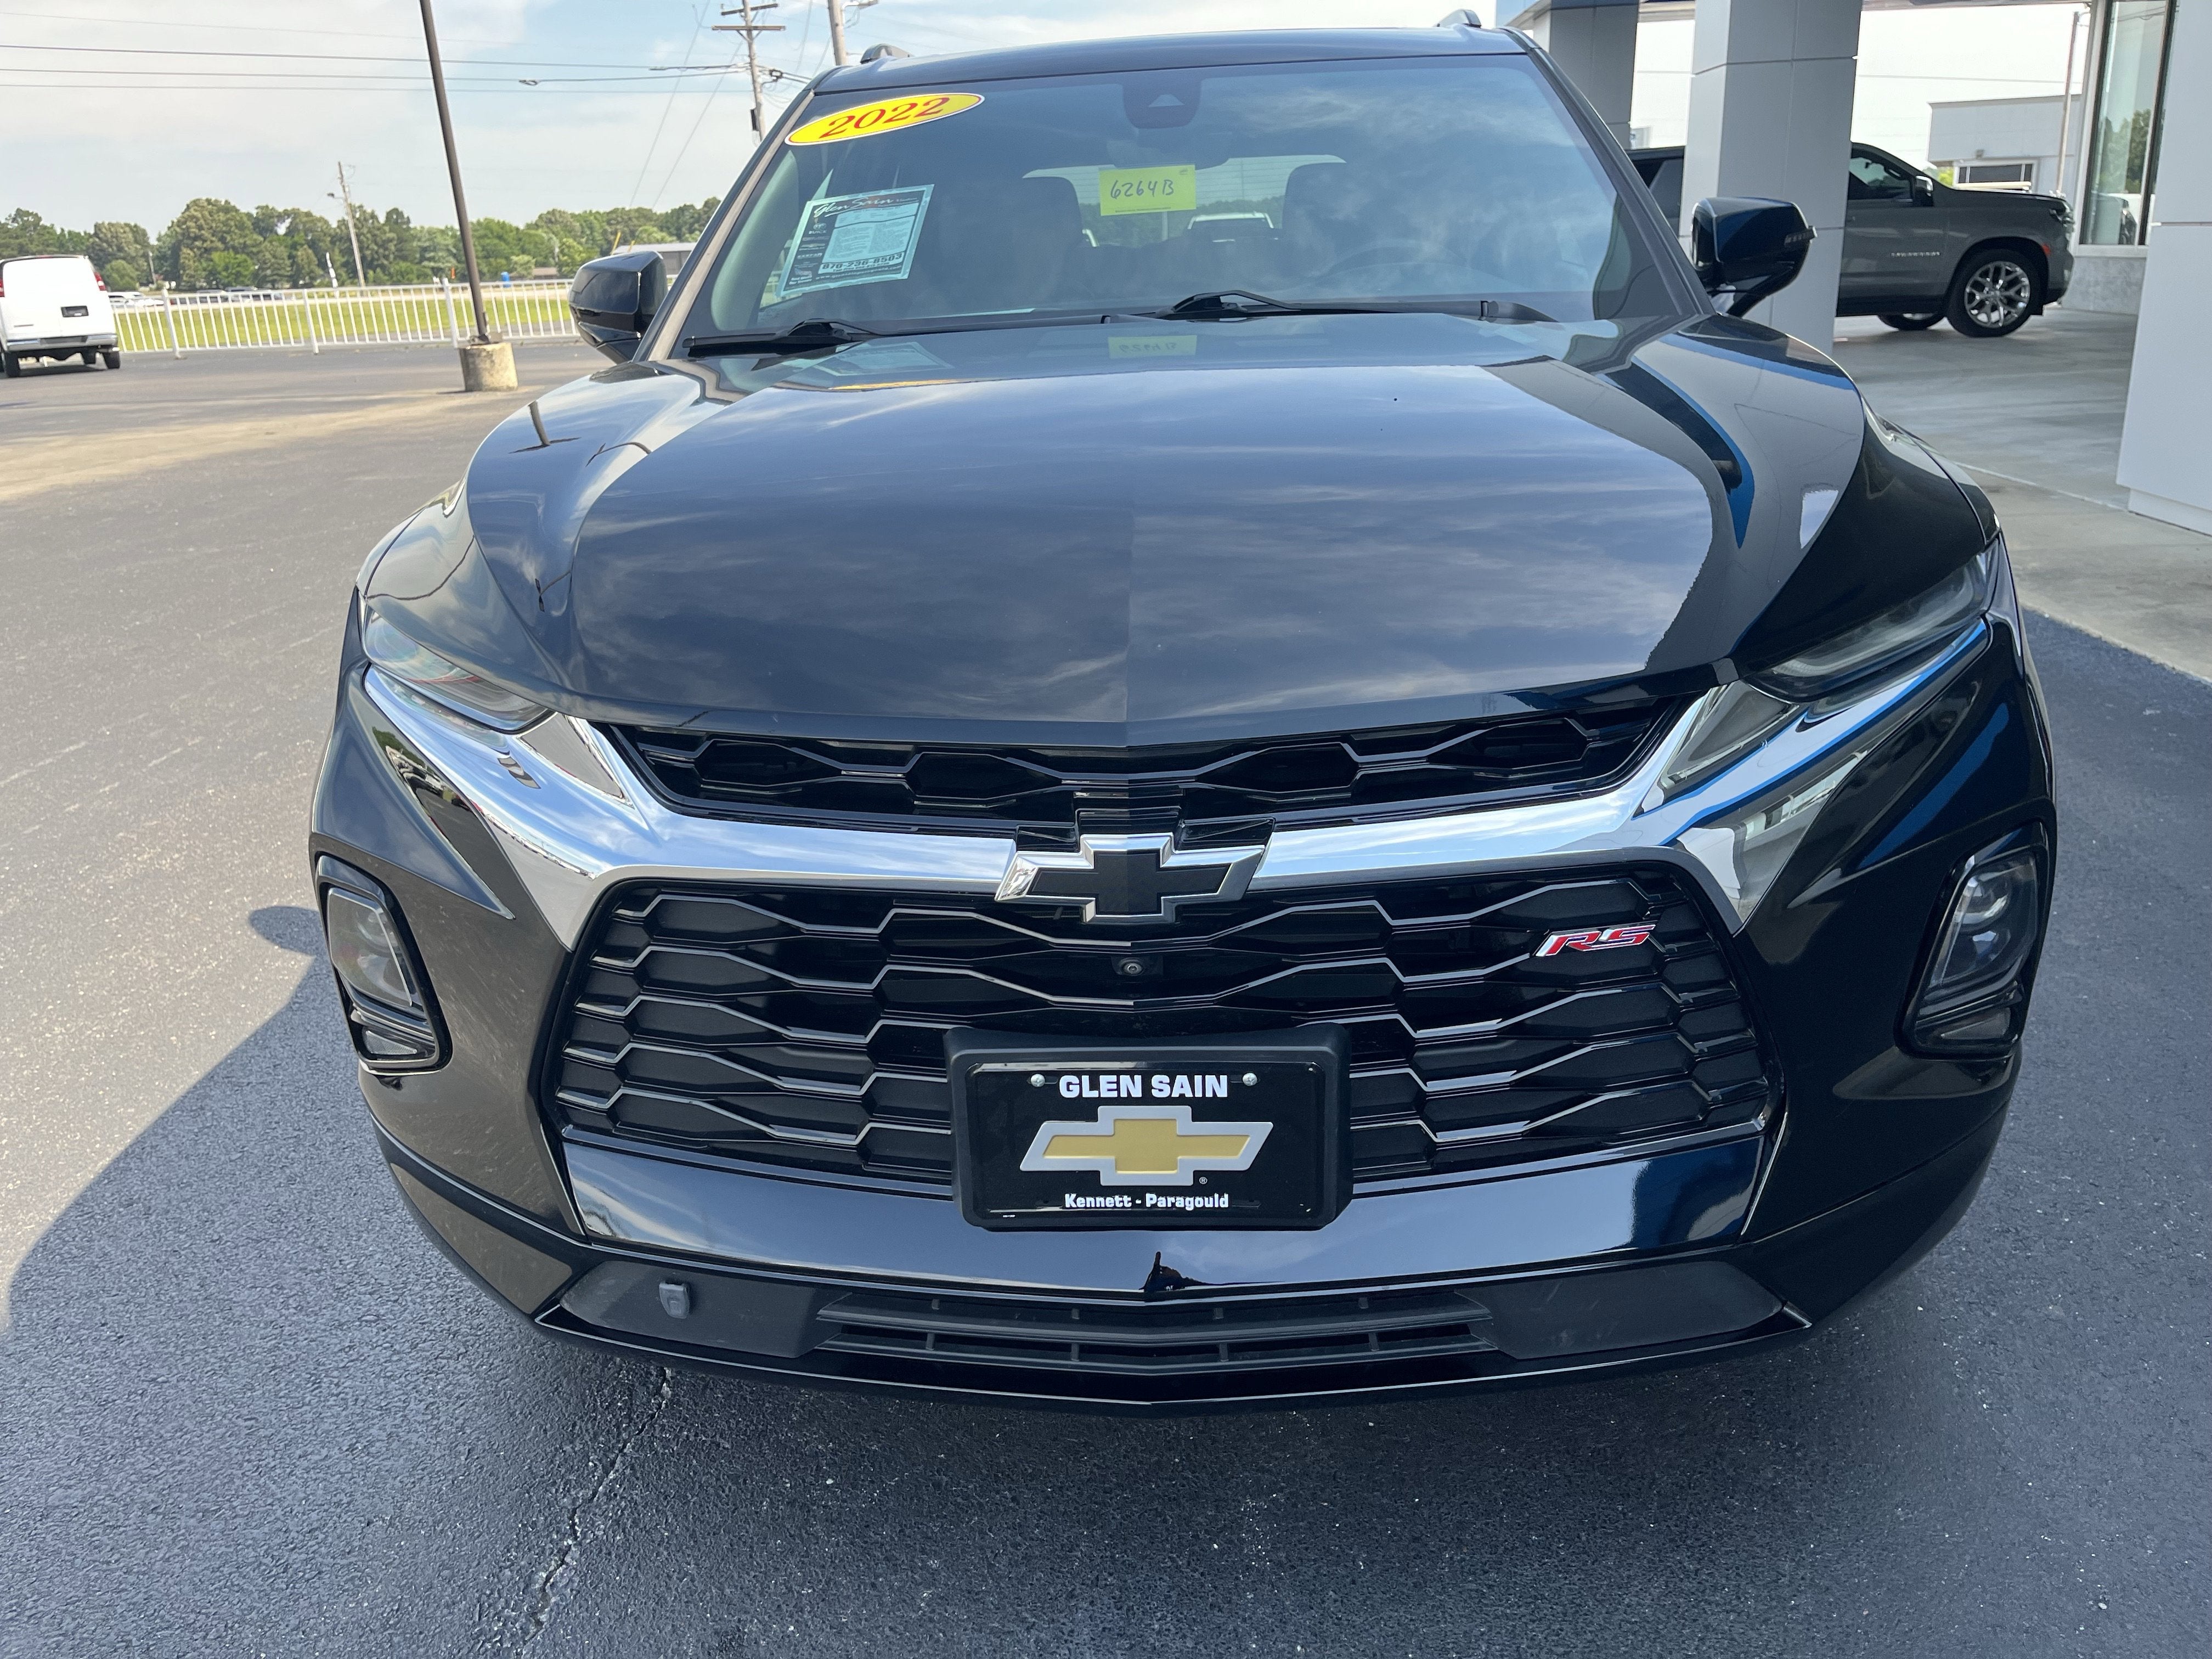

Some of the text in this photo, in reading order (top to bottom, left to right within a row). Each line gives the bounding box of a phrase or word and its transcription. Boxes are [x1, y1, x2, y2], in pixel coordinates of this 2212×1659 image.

[819, 97, 950, 139] 2022
[1110, 179, 1174, 200] 6264B
[813, 202, 851, 218] Glen
[1536, 924, 1656, 957] RS
[1059, 1075, 1228, 1098] GLEN SAIN
[1065, 1193, 1132, 1207] Kennett
[1146, 1193, 1229, 1211] Paragould
